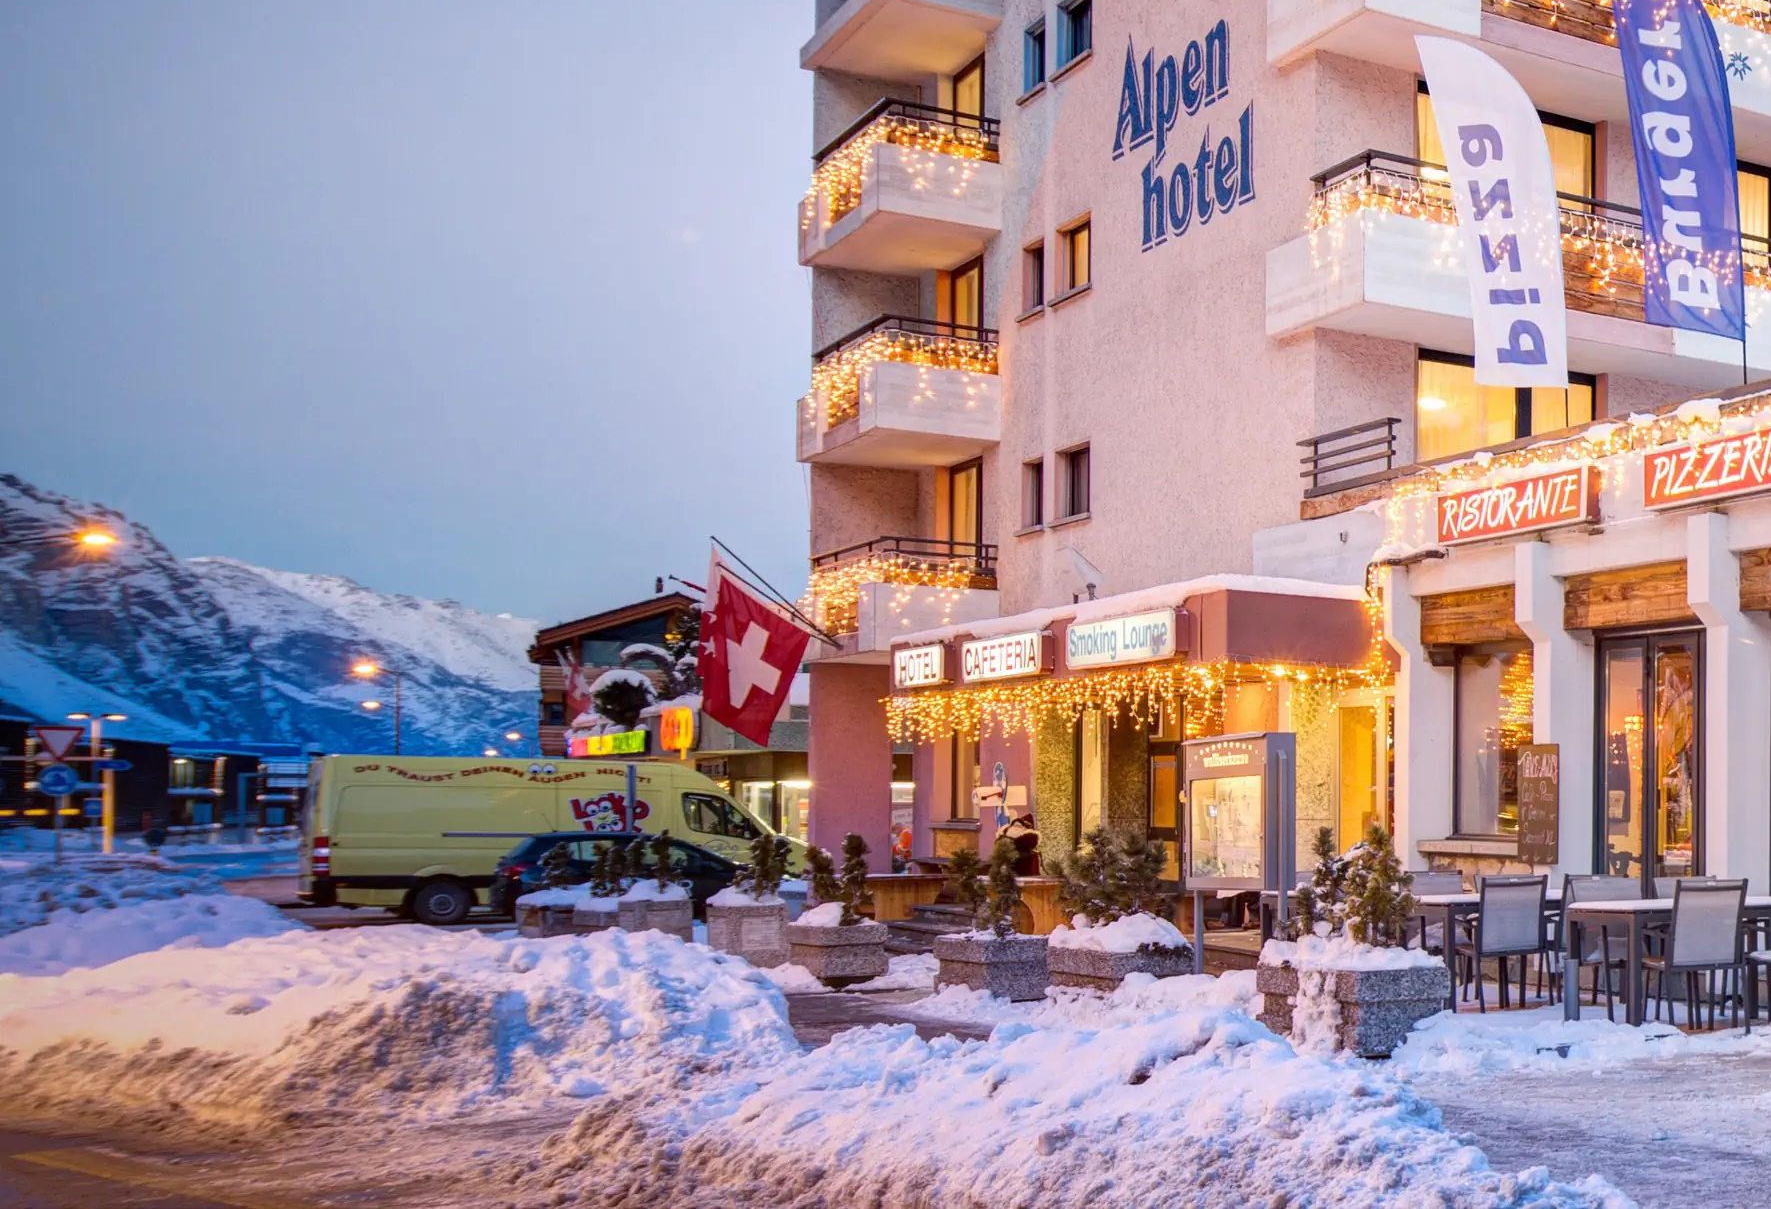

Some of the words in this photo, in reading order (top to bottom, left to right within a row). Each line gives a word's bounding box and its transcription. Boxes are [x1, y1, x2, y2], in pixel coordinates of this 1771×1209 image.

[1112, 19, 1230, 168] Alpen
[1141, 99, 1256, 254] hotel
[1442, 474, 1578, 539] RISTORANTE
[964, 637, 1036, 677] CAFETERIA
[1070, 625, 1117, 660] Smoking
[1123, 619, 1167, 656] Lounge
[899, 651, 937, 683] HOTEL
[353, 764, 381, 774] DU
[386, 766, 456, 782] TRAUST
[460, 765, 524, 778] DEINEN
[528, 771, 586, 783] AUGEN
[595, 768, 651, 784] NICT!
